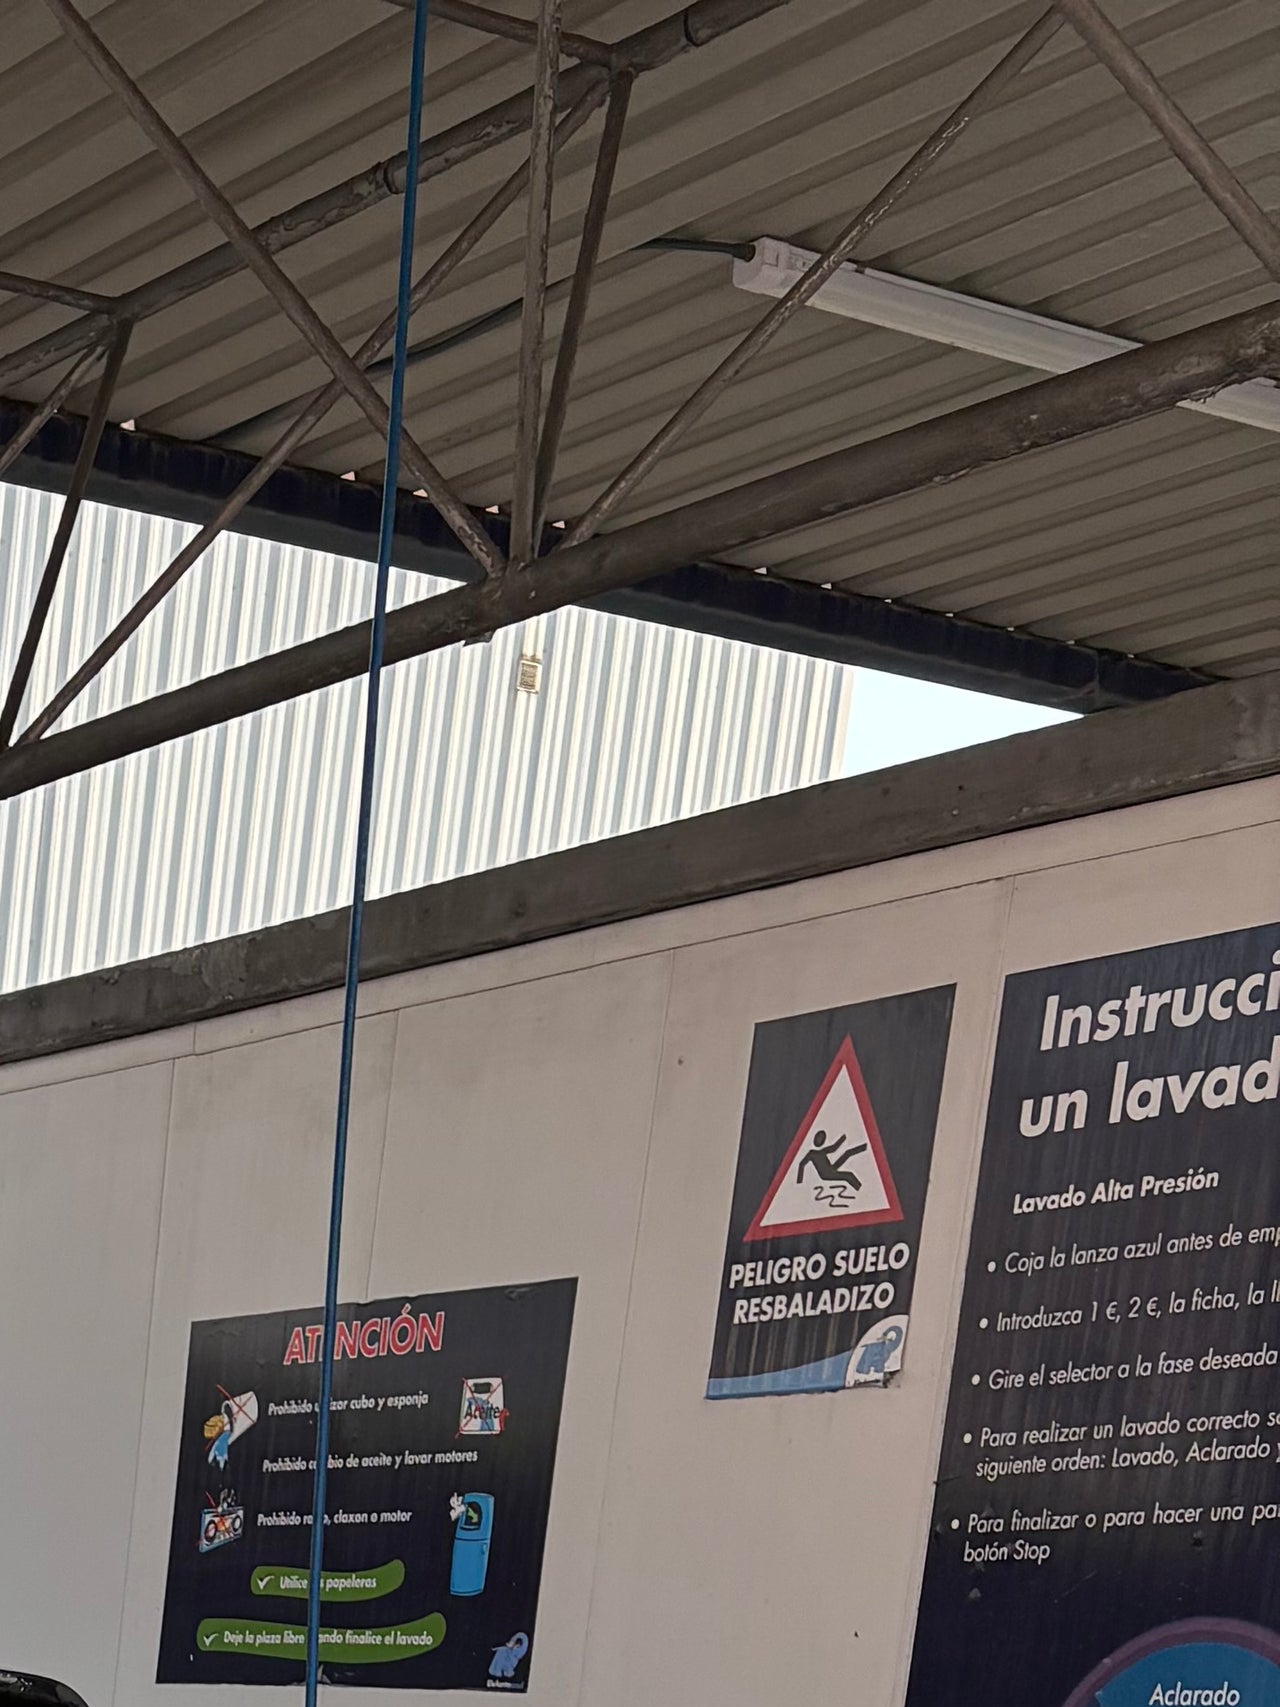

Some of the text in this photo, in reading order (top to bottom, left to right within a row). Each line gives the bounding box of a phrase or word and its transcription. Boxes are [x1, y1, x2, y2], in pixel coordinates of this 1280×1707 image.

[1040, 950, 1280, 1051] Instrucci
[1019, 1035, 1280, 1137] un lavad
[1012, 1167, 1219, 1214] Lavado Alta Presión
[729, 1242, 910, 1289] PELIGRO SUELO
[1004, 1252, 1044, 1277] Coja
[1050, 1246, 1065, 1268] la
[1071, 1243, 1118, 1266] lanza
[1124, 1233, 1162, 1259] azul
[1167, 1232, 1213, 1253] antes
[1219, 1223, 1242, 1247] de
[733, 1281, 895, 1325] RESBALADIZO
[996, 1306, 1083, 1332] Introduzca
[1092, 1301, 1098, 1322] 1
[1128, 1297, 1141, 1318] 2
[1168, 1291, 1185, 1314] la
[1191, 1286, 1240, 1311] ficha,
[1247, 1282, 1265, 1305] la
[283, 1303, 445, 1365] ATNCIÓN
[989, 1342, 1277, 1390] Gire el selector a la fase deseada
[268, 1400, 312, 1416] Prohibido
[350, 1395, 375, 1409] cubo
[377, 1398, 384, 1411] y
[387, 1391, 429, 1408] esponja
[980, 1427, 1016, 1448] Para
[1023, 1420, 1087, 1445] realizar
[1093, 1423, 1113, 1440] un
[1120, 1412, 1180, 1437] lavado
[1186, 1410, 1260, 1433] correcto
[263, 1451, 478, 1473] Prohibido cabio de aceite y lavar motores
[976, 1454, 1046, 1482] siguiente
[1051, 1448, 1105, 1472] orden:
[1111, 1445, 1179, 1469] Lavado,
[1185, 1434, 1270, 1462] Aclarado
[257, 1511, 301, 1526] Prohibido
[380, 1511, 412, 1523] motor
[968, 1513, 1003, 1533] Para
[1010, 1508, 1079, 1531] finalizar
[1085, 1513, 1096, 1528] o
[1102, 1510, 1145, 1533] para
[1153, 1501, 1203, 1525] hacer
[1210, 1506, 1244, 1522] una
[963, 1539, 1050, 1565] botón Stop
[326, 1573, 377, 1592] papeleras
[245, 1630, 255, 1644] la
[256, 1630, 281, 1647] plaza
[345, 1630, 381, 1645] finalice
[384, 1630, 394, 1645] el
[396, 1631, 433, 1646] lavado
[1149, 1681, 1240, 1707] Aclarado
